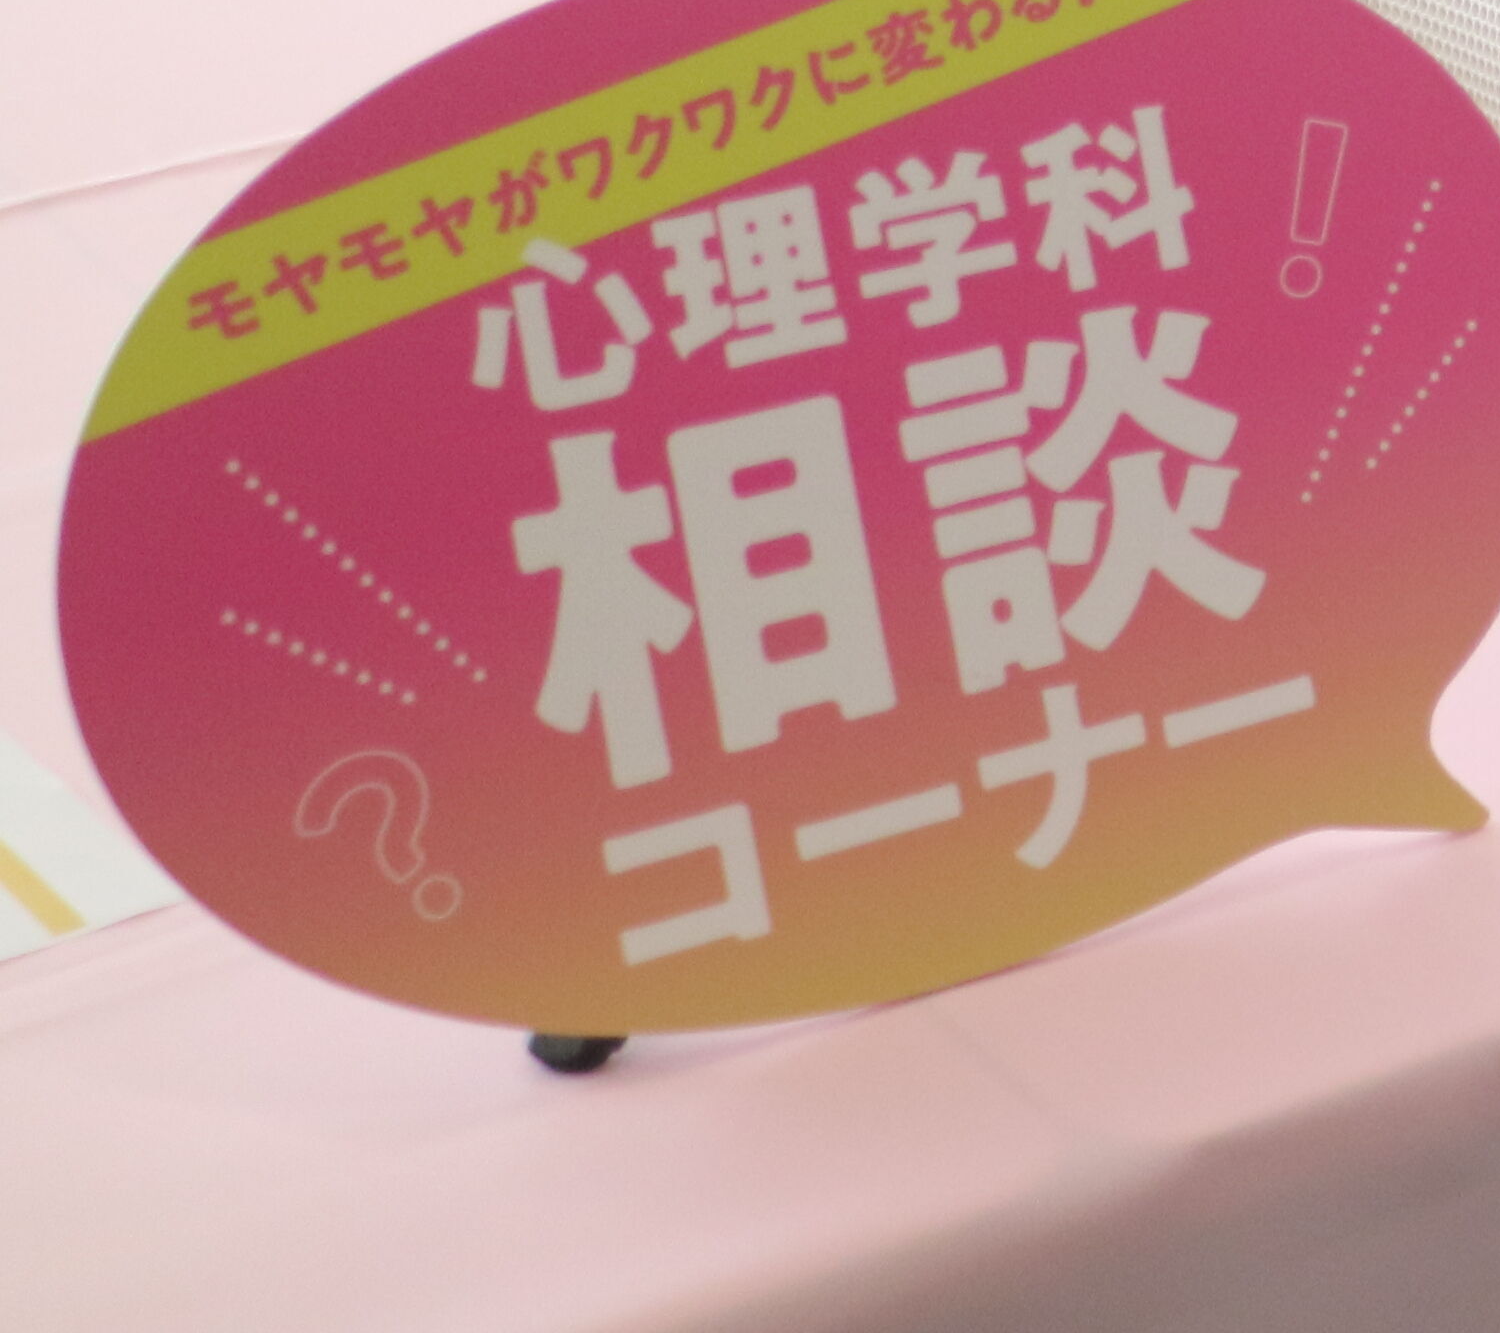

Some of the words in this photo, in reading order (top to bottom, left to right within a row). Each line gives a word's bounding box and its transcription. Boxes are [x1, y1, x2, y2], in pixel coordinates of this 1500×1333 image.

[471, 104, 1196, 413] 心理学科
[512, 306, 1267, 791] 相談
[602, 673, 1316, 965] コーナー
